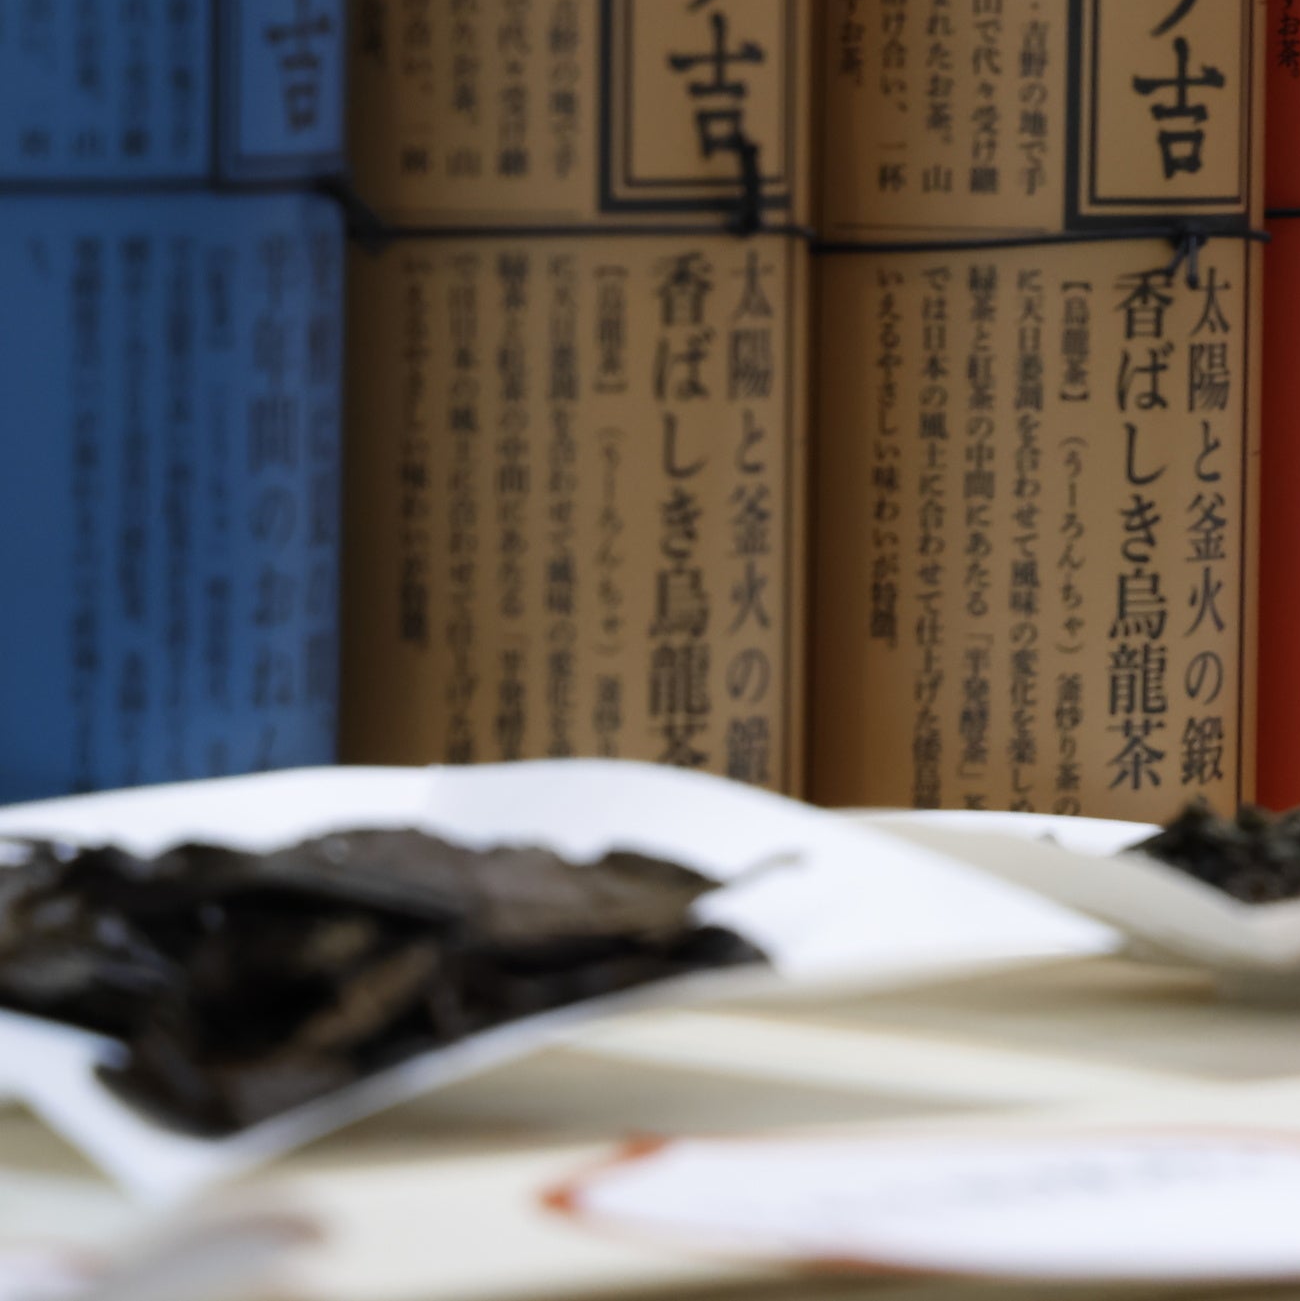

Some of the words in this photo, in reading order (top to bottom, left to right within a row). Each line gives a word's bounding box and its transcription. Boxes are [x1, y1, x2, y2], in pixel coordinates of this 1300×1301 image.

[1105, 269, 1176, 791] 香ばしき烏龍茶
[1180, 266, 1231, 786] 太陽と釜火の鍛
